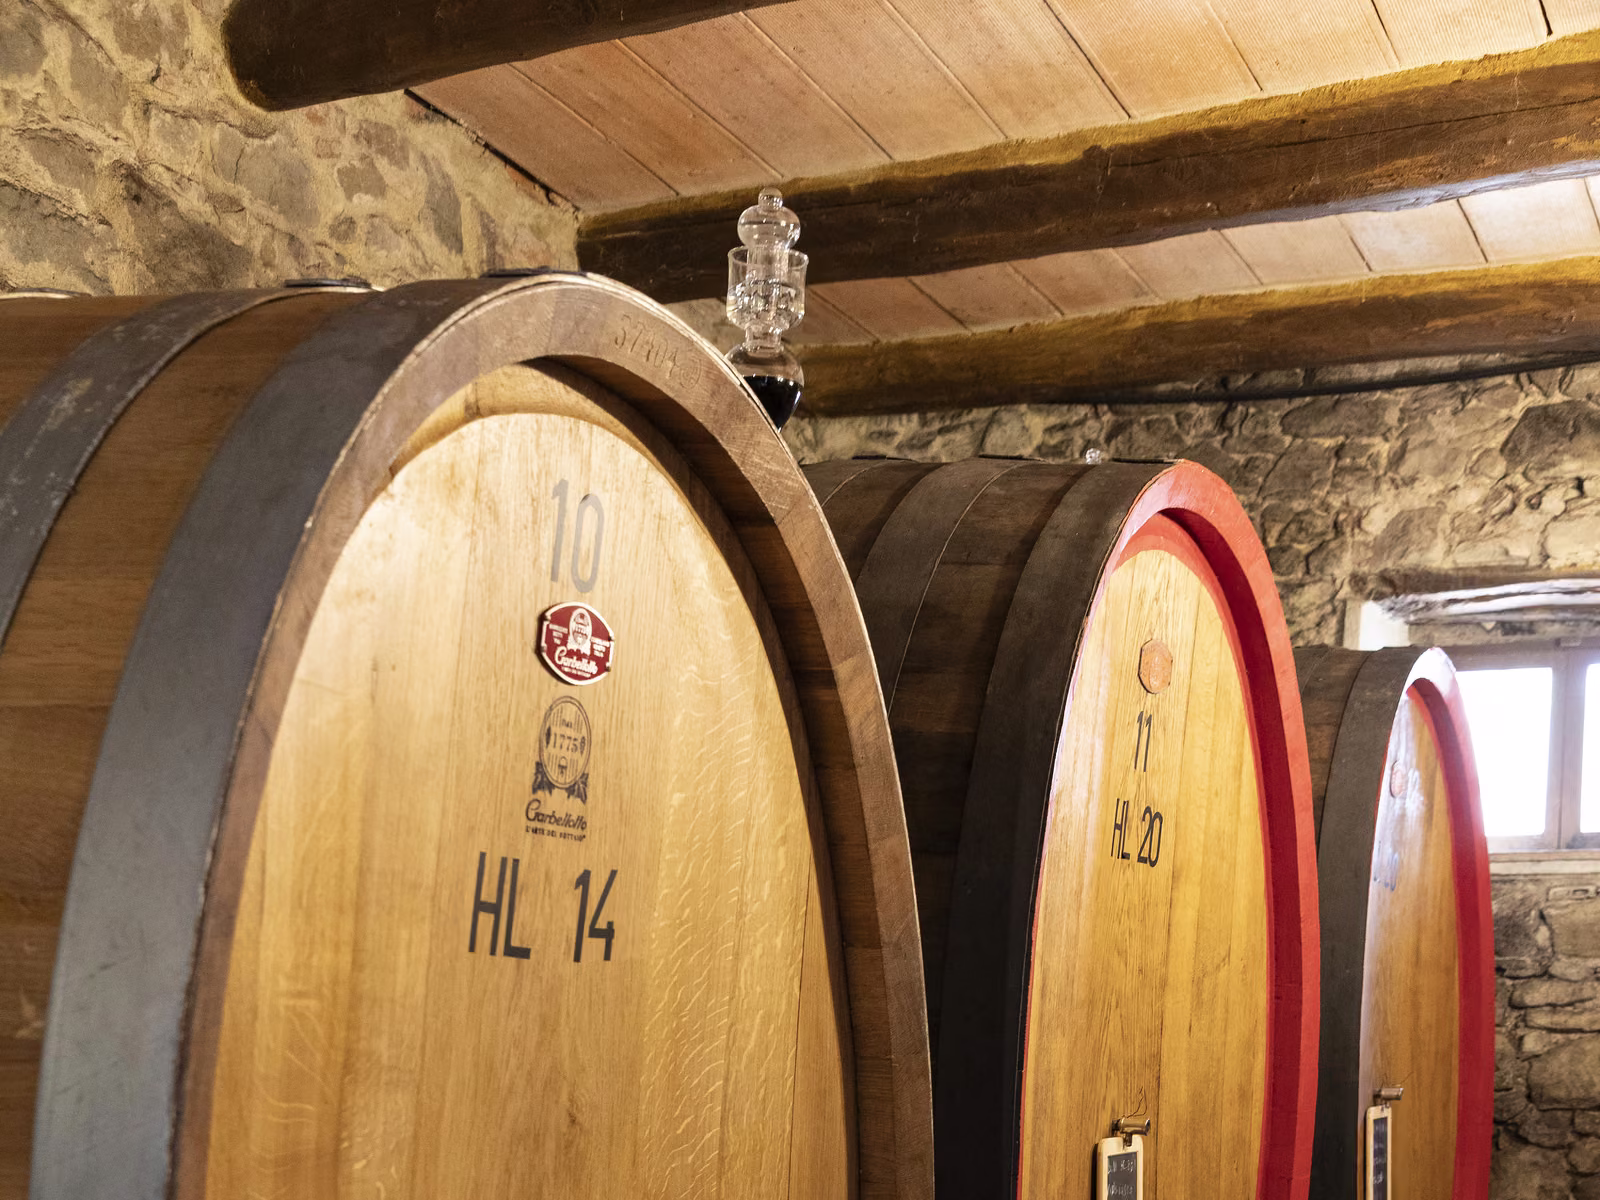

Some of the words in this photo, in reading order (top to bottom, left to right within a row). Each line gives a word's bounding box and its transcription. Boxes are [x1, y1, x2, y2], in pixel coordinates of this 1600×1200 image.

[551, 478, 605, 593] 10
[553, 732, 578, 753] 1775
[1134, 710, 1152, 772] 11
[525, 798, 587, 831] Garbellotto
[1111, 798, 1131, 860] HL
[1137, 806, 1163, 867] 20
[468, 851, 531, 960] HL
[573, 869, 618, 963] 14
